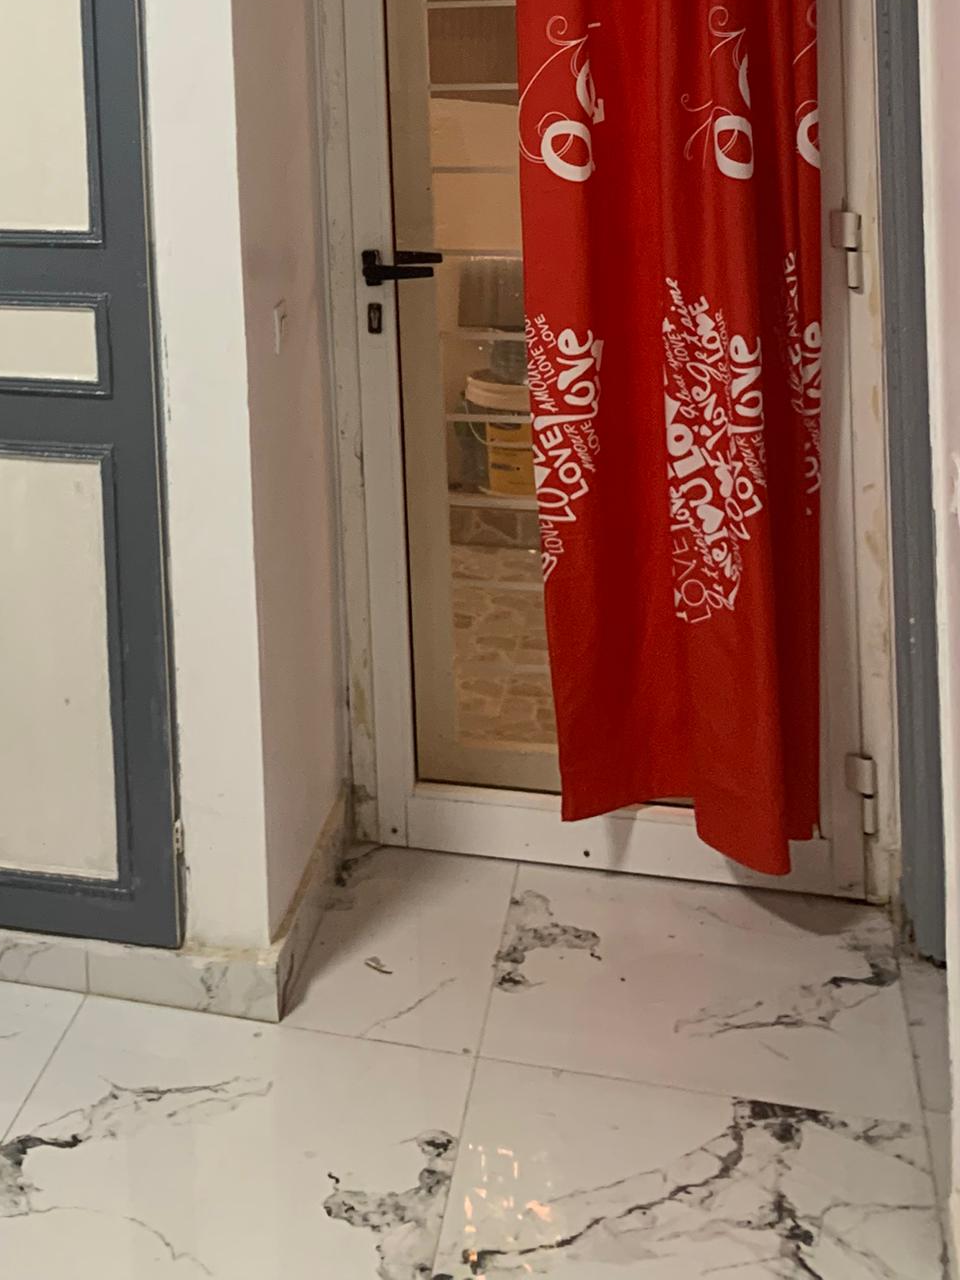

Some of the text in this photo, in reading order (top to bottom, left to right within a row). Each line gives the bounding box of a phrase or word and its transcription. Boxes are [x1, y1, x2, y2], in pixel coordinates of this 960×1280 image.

[534, 313, 557, 349] LOVE
[530, 345, 556, 379] LOVE
[539, 425, 590, 500] LOVE
